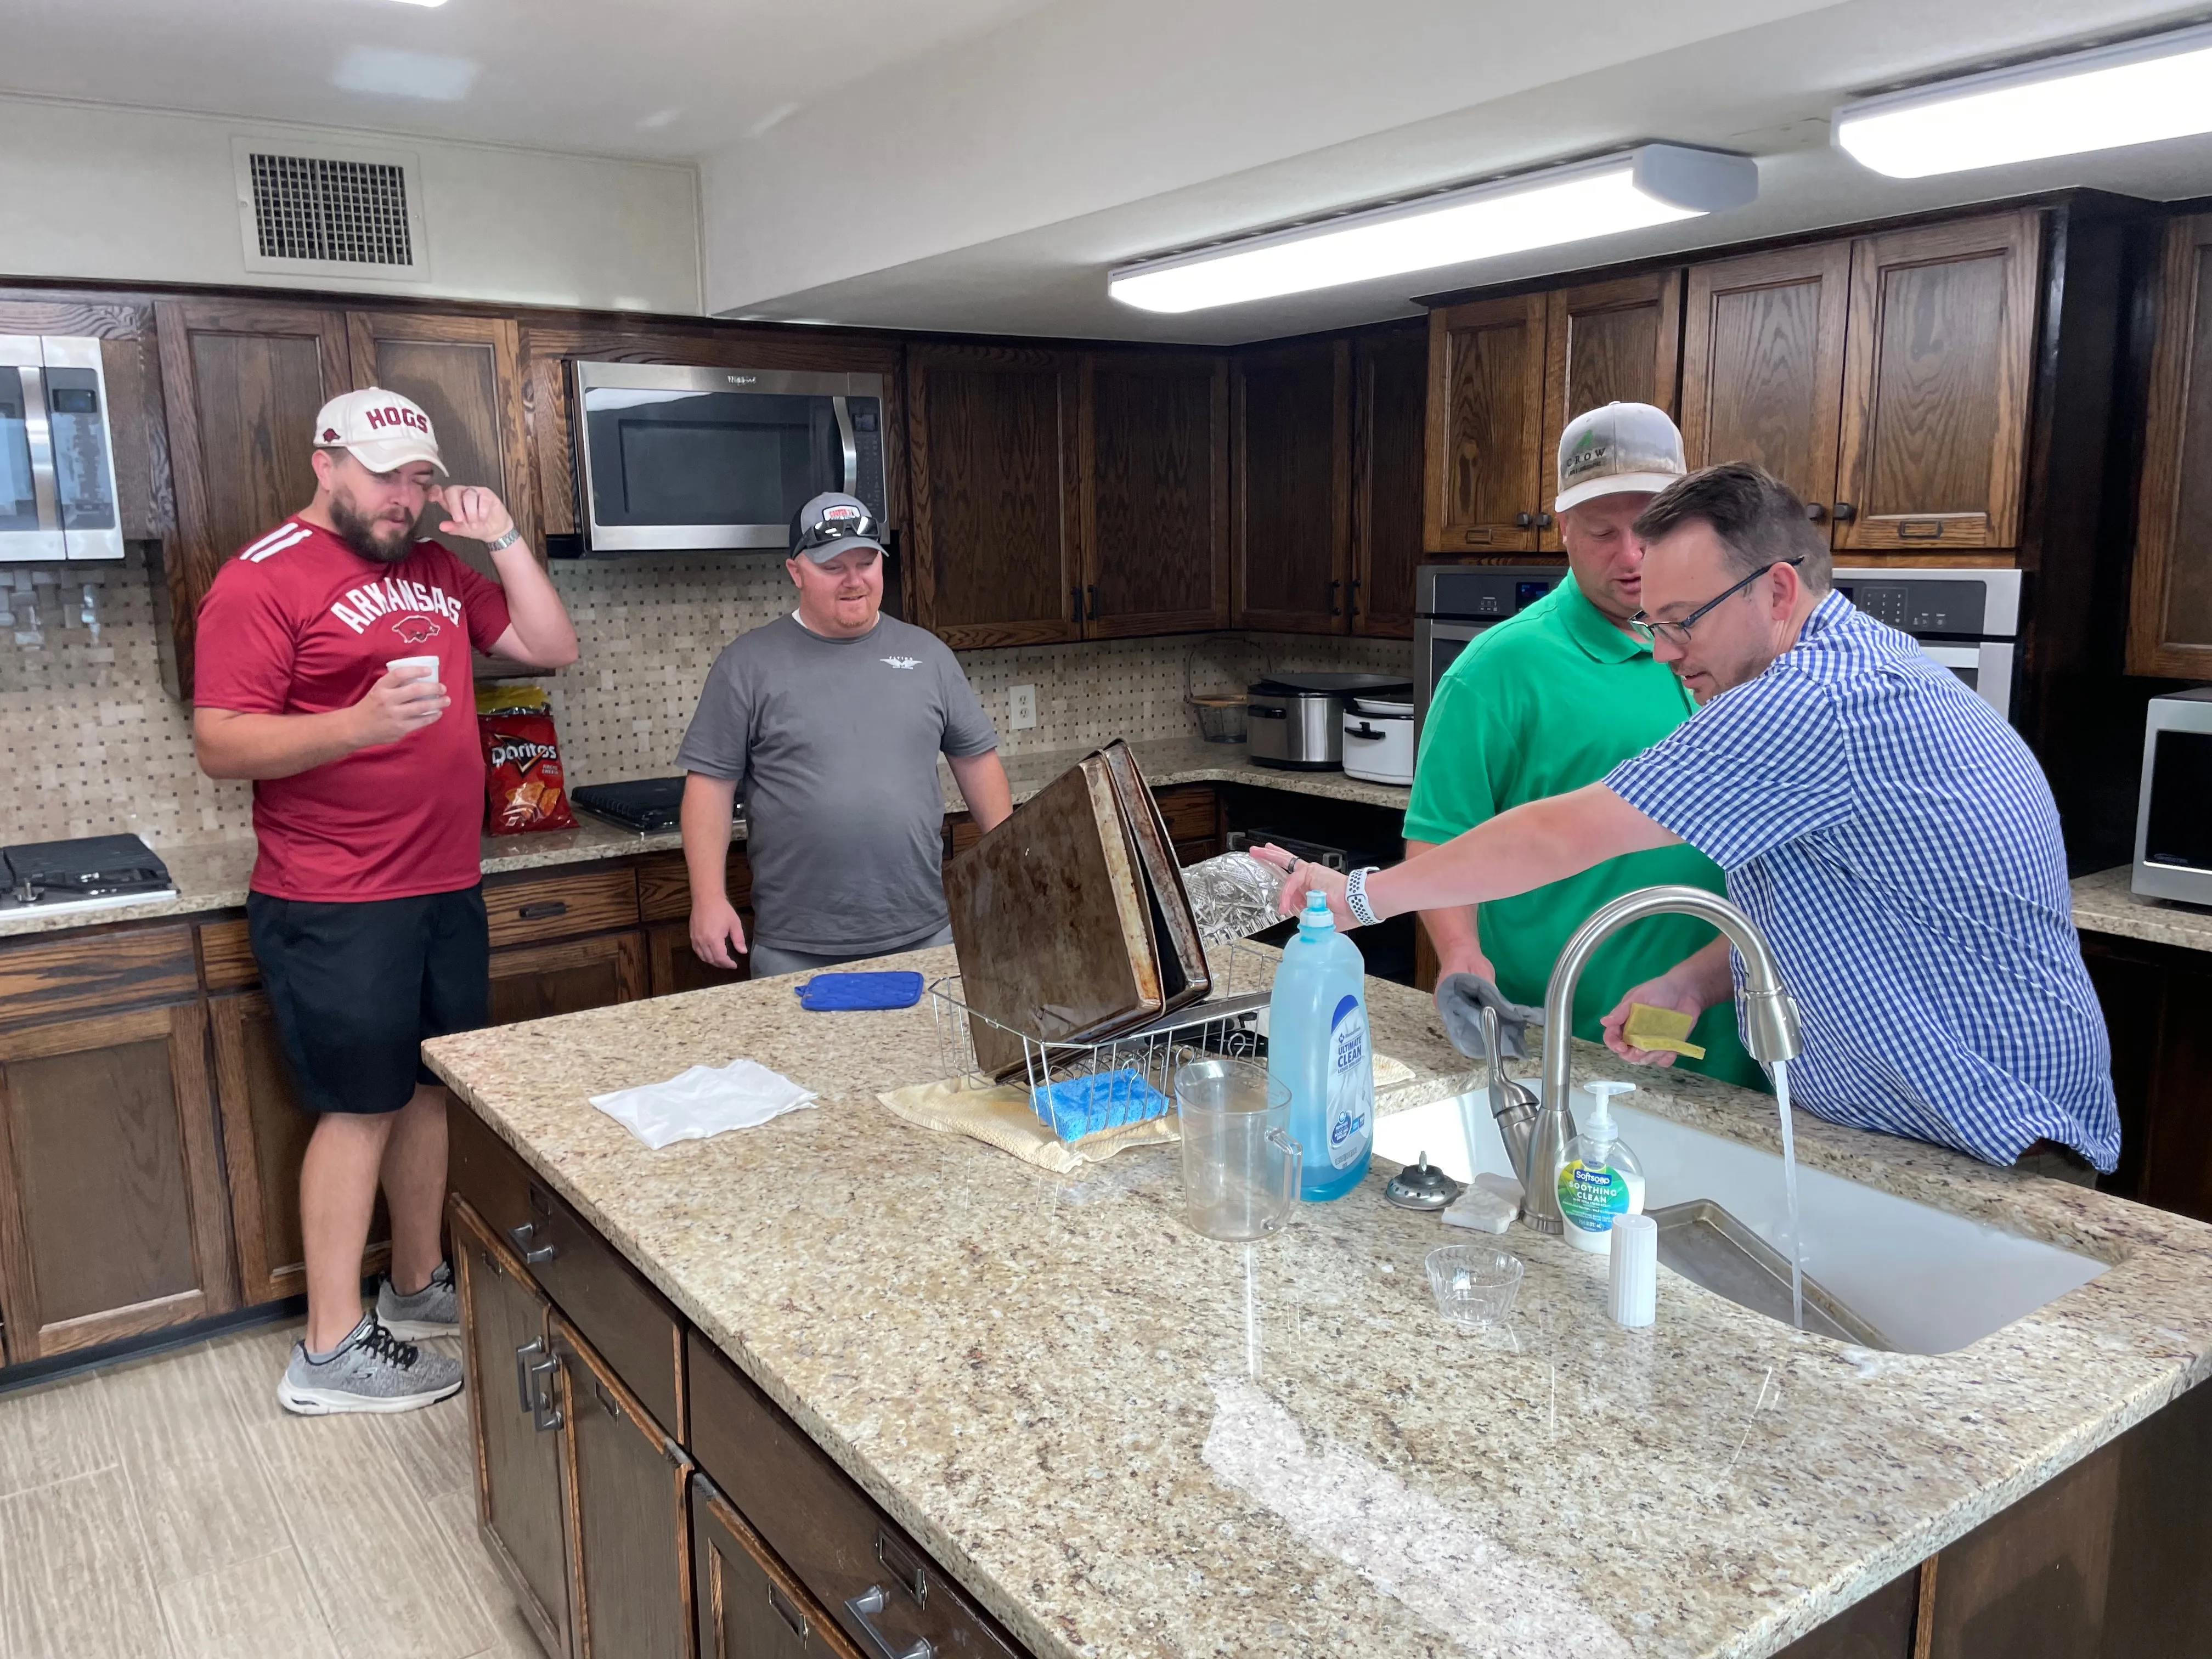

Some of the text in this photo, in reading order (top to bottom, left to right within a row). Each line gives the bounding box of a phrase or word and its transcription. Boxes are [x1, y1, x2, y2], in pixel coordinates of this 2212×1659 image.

[366, 407, 428, 433] HOGS
[1567, 447, 1605, 467] CROW
[330, 577, 461, 635] ARKANSAS
[492, 743, 556, 765] Doritos
[1338, 1035, 1361, 1056] ULTIMATE
[1338, 1044, 1362, 1068] CLEAN
[1576, 1171, 1610, 1185] Softsoap
[1569, 1181, 1617, 1197] SOOTHING
[1577, 1192, 1607, 1204] CLEAN
